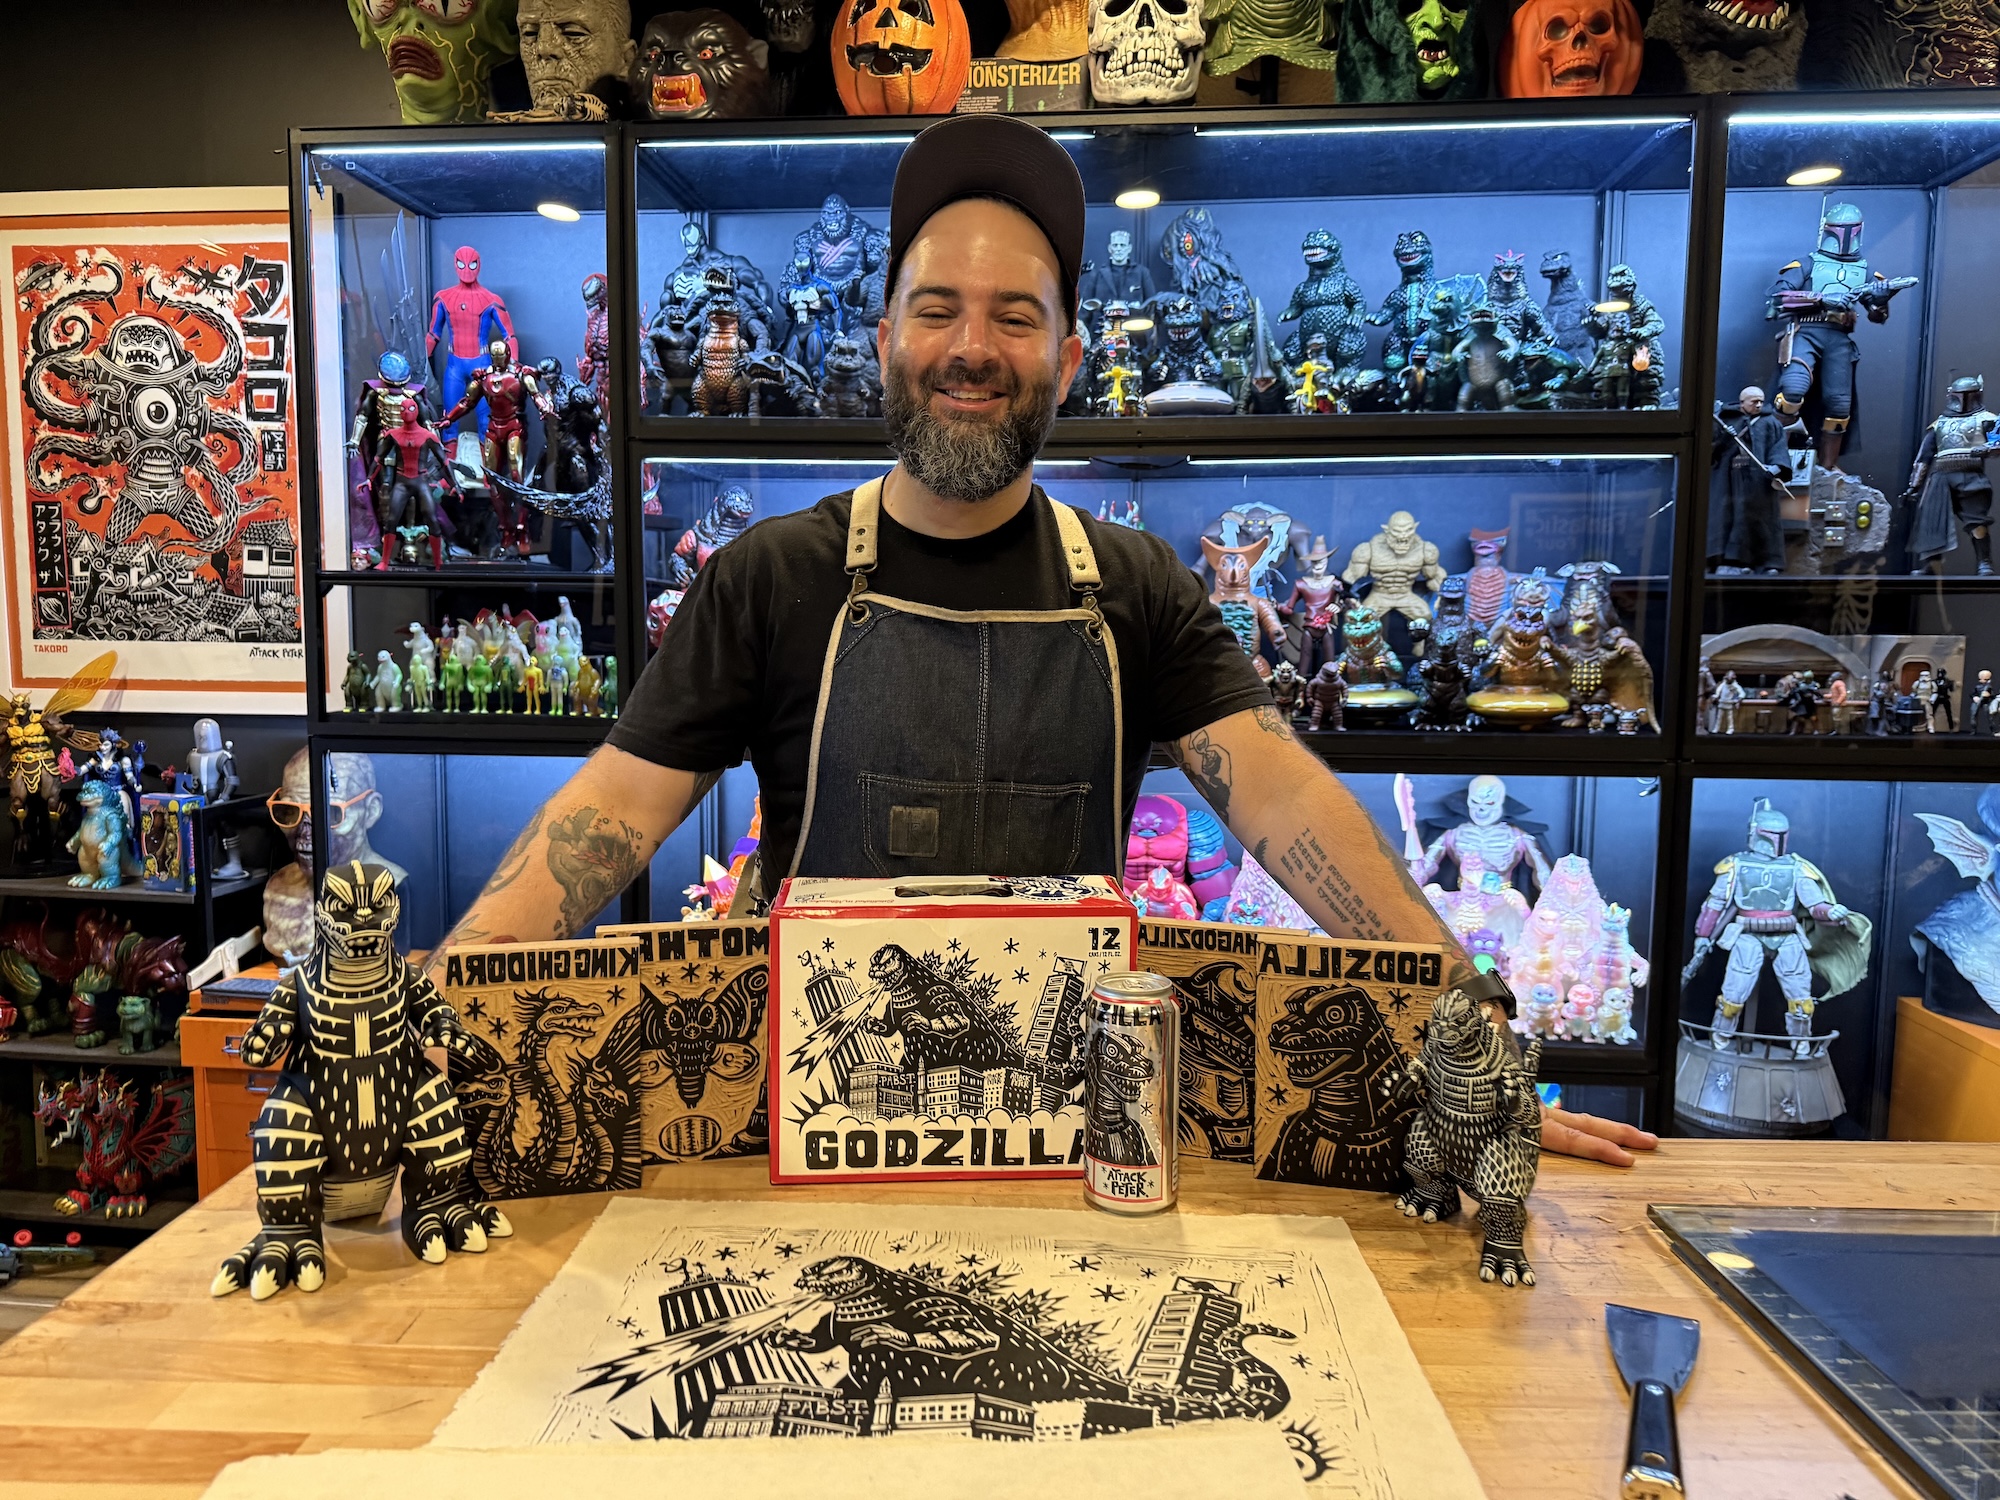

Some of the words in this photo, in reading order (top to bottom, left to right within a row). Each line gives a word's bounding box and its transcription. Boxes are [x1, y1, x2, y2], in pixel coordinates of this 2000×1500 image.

[34, 644, 68, 653] TAKORO
[249, 646, 280, 658] ATTACK
[1287, 846, 1304, 871] form
[1304, 871, 1317, 884] of
[1317, 886, 1350, 923] tyranny
[1294, 838, 1323, 877] eternal
[1323, 876, 1367, 925] hostility
[1301, 827, 1310, 837] I
[1308, 836, 1328, 862] have
[1327, 864, 1352, 893] sworn
[1352, 894, 1364, 908] on
[1366, 909, 1382, 929] the
[1088, 927, 1121, 951] 12
[881, 1073, 915, 1088] PABST
[1107, 1167, 1147, 1183] ATTACK
[786, 1399, 868, 1418] PABST
